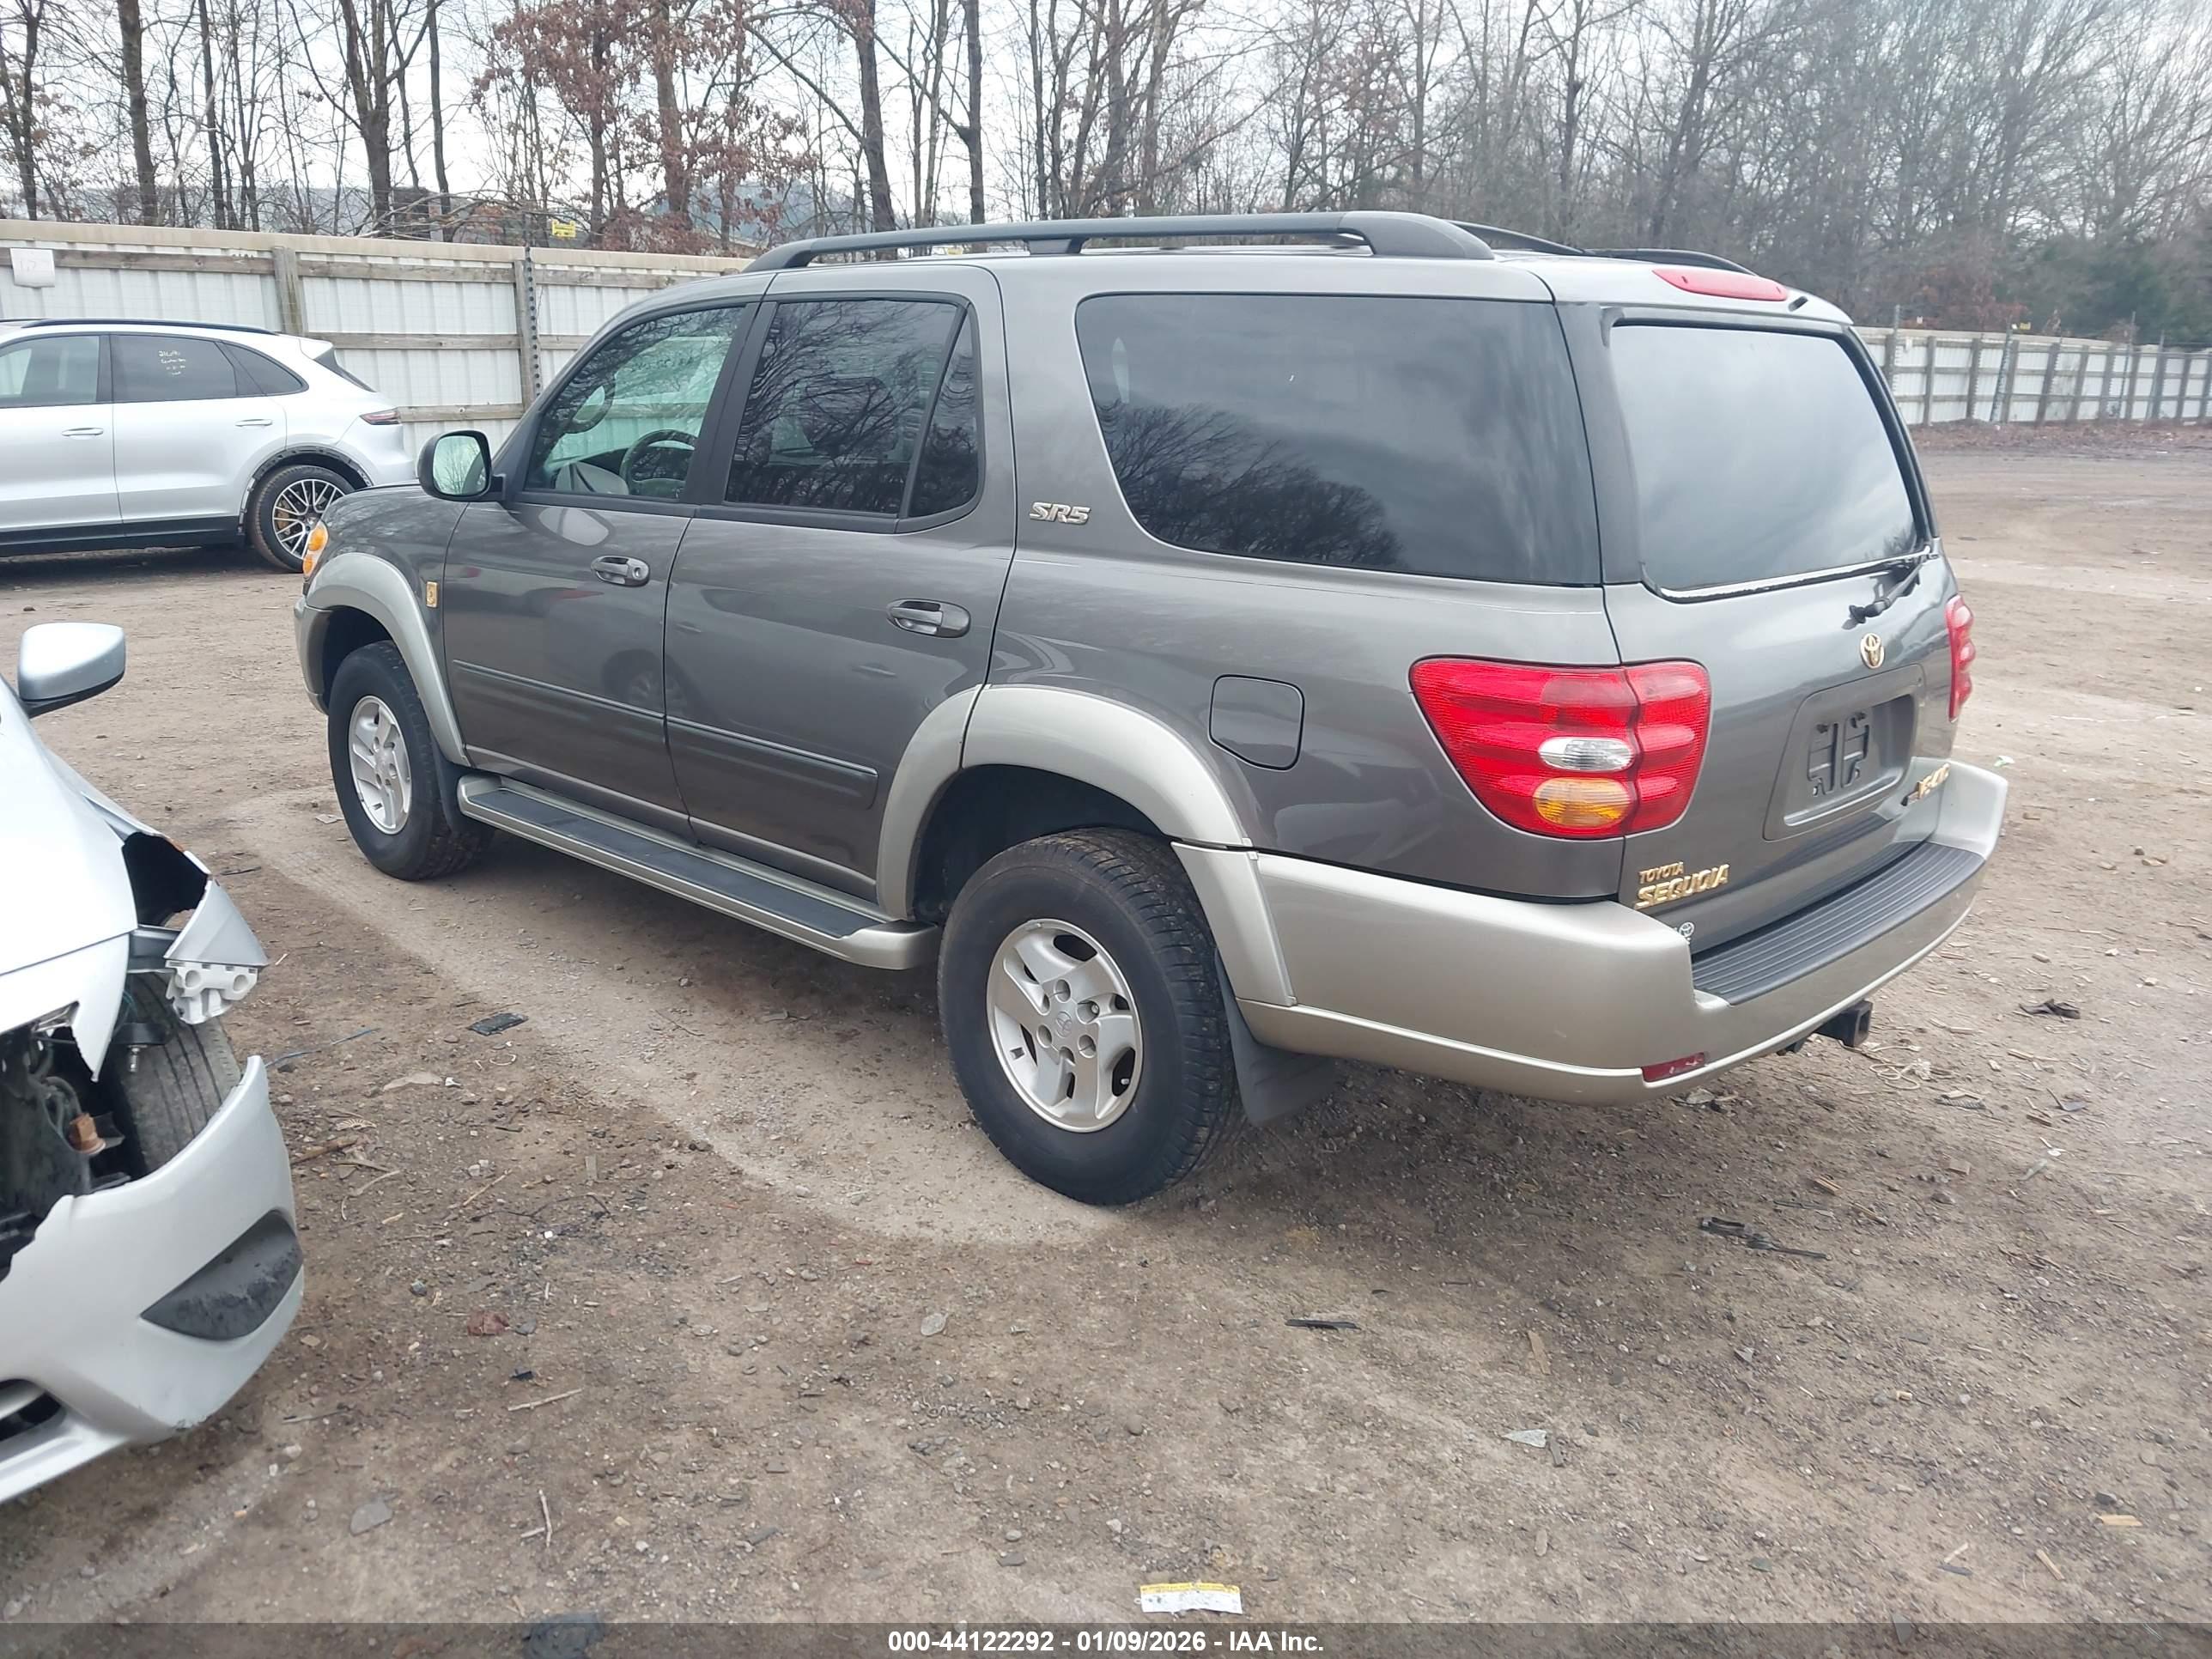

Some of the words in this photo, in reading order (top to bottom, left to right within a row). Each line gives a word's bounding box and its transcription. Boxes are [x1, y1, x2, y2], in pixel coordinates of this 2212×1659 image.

[1030, 501, 1091, 525] SR5
[1639, 861, 1683, 884] TOYOTA
[1634, 864, 1729, 909] SEQUOIA
